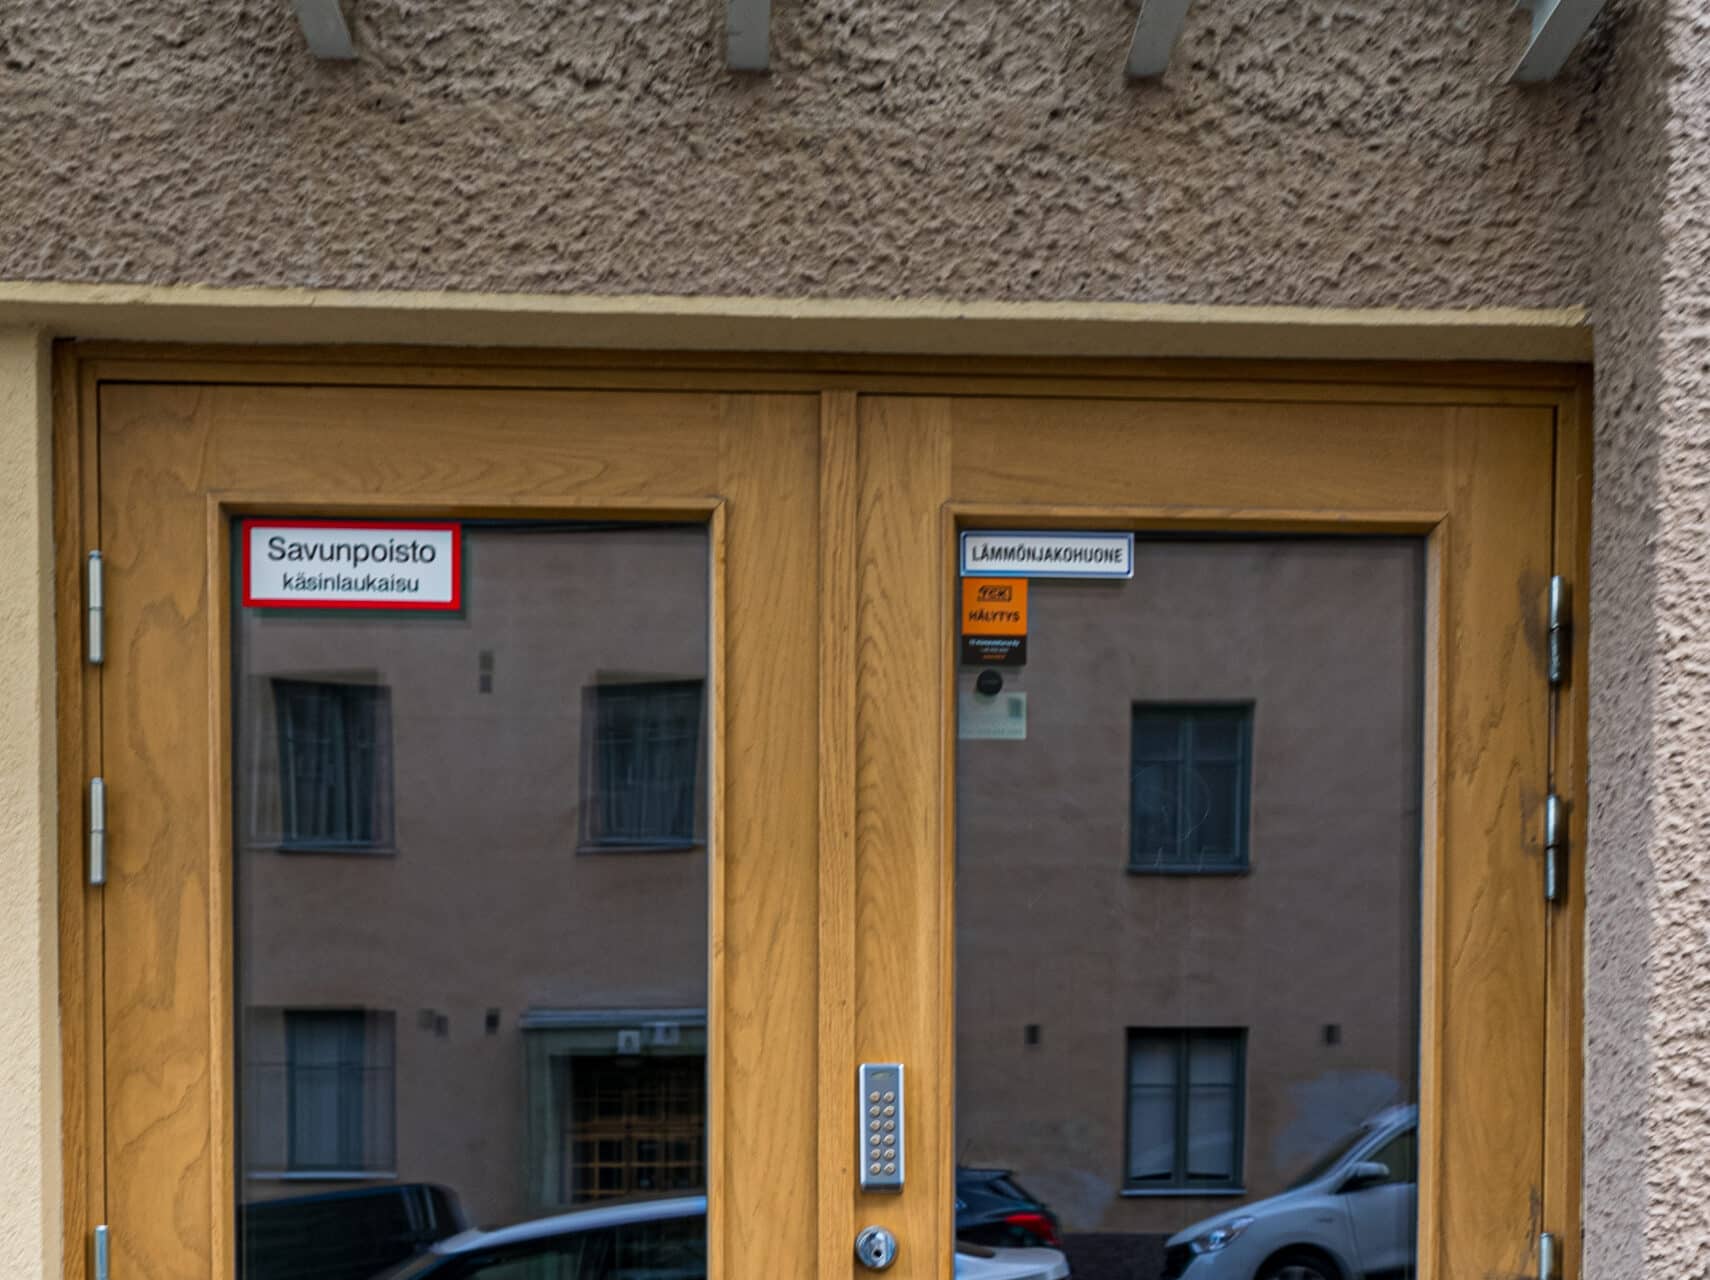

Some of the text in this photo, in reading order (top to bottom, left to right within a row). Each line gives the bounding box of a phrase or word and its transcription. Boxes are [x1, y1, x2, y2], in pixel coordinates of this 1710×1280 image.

[268, 536, 436, 567] Savunpoisto
[972, 543, 1122, 563] LÄMMÖNJAKOHUONE
[283, 572, 419, 593] käsinlaukaisu
[969, 609, 1020, 622] HÄLYTYS
